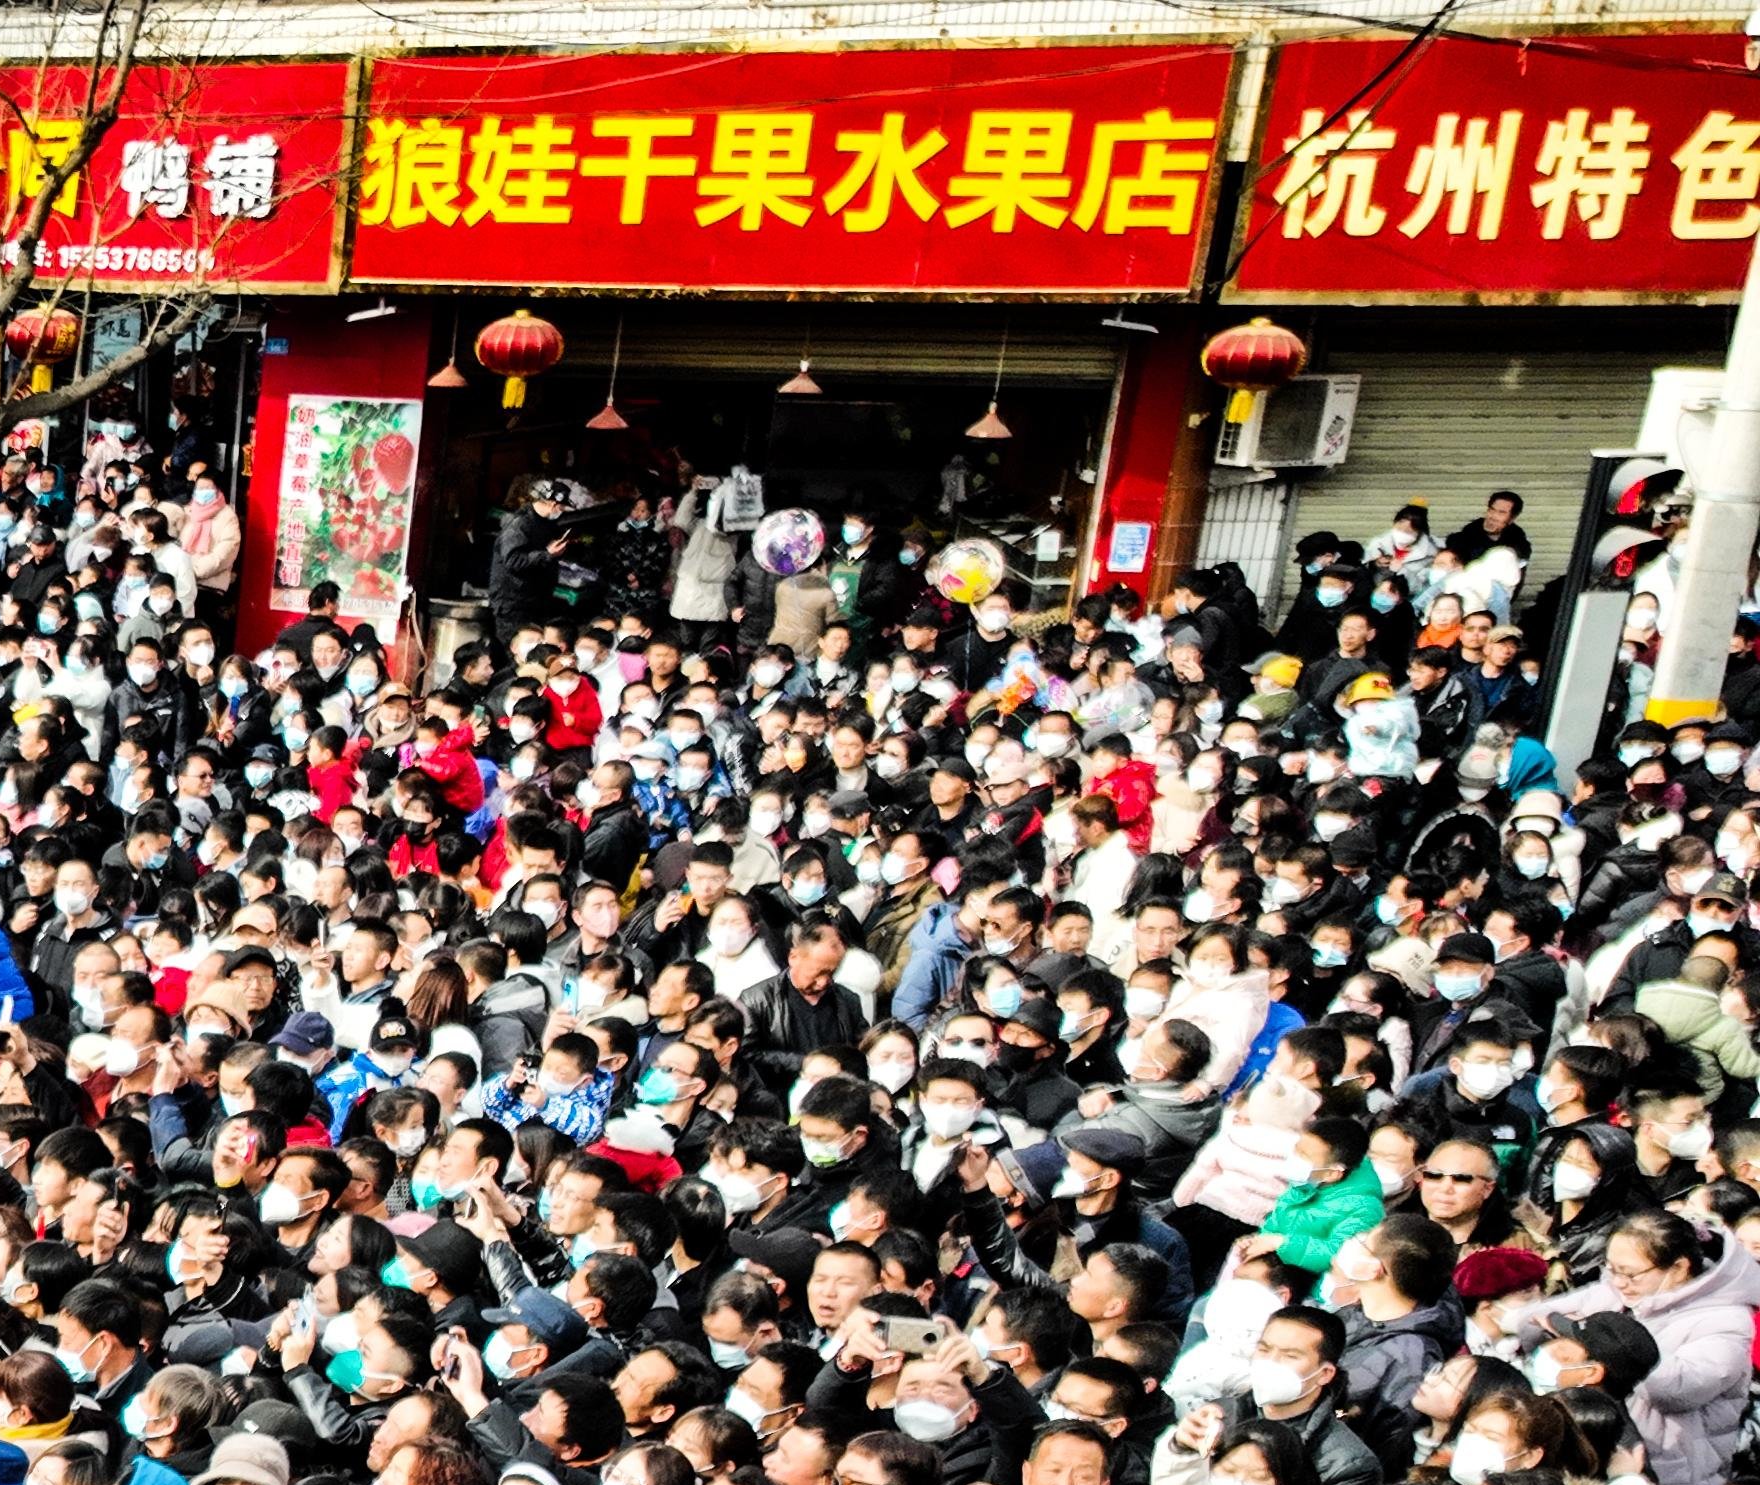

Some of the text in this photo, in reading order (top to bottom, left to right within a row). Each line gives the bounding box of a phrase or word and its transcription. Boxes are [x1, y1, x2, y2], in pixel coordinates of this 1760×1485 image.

[123, 134, 279, 219] 鸭铺
[359, 109, 1216, 235] 狼娃干果水果店
[1273, 108, 1760, 241] 杭州特色
